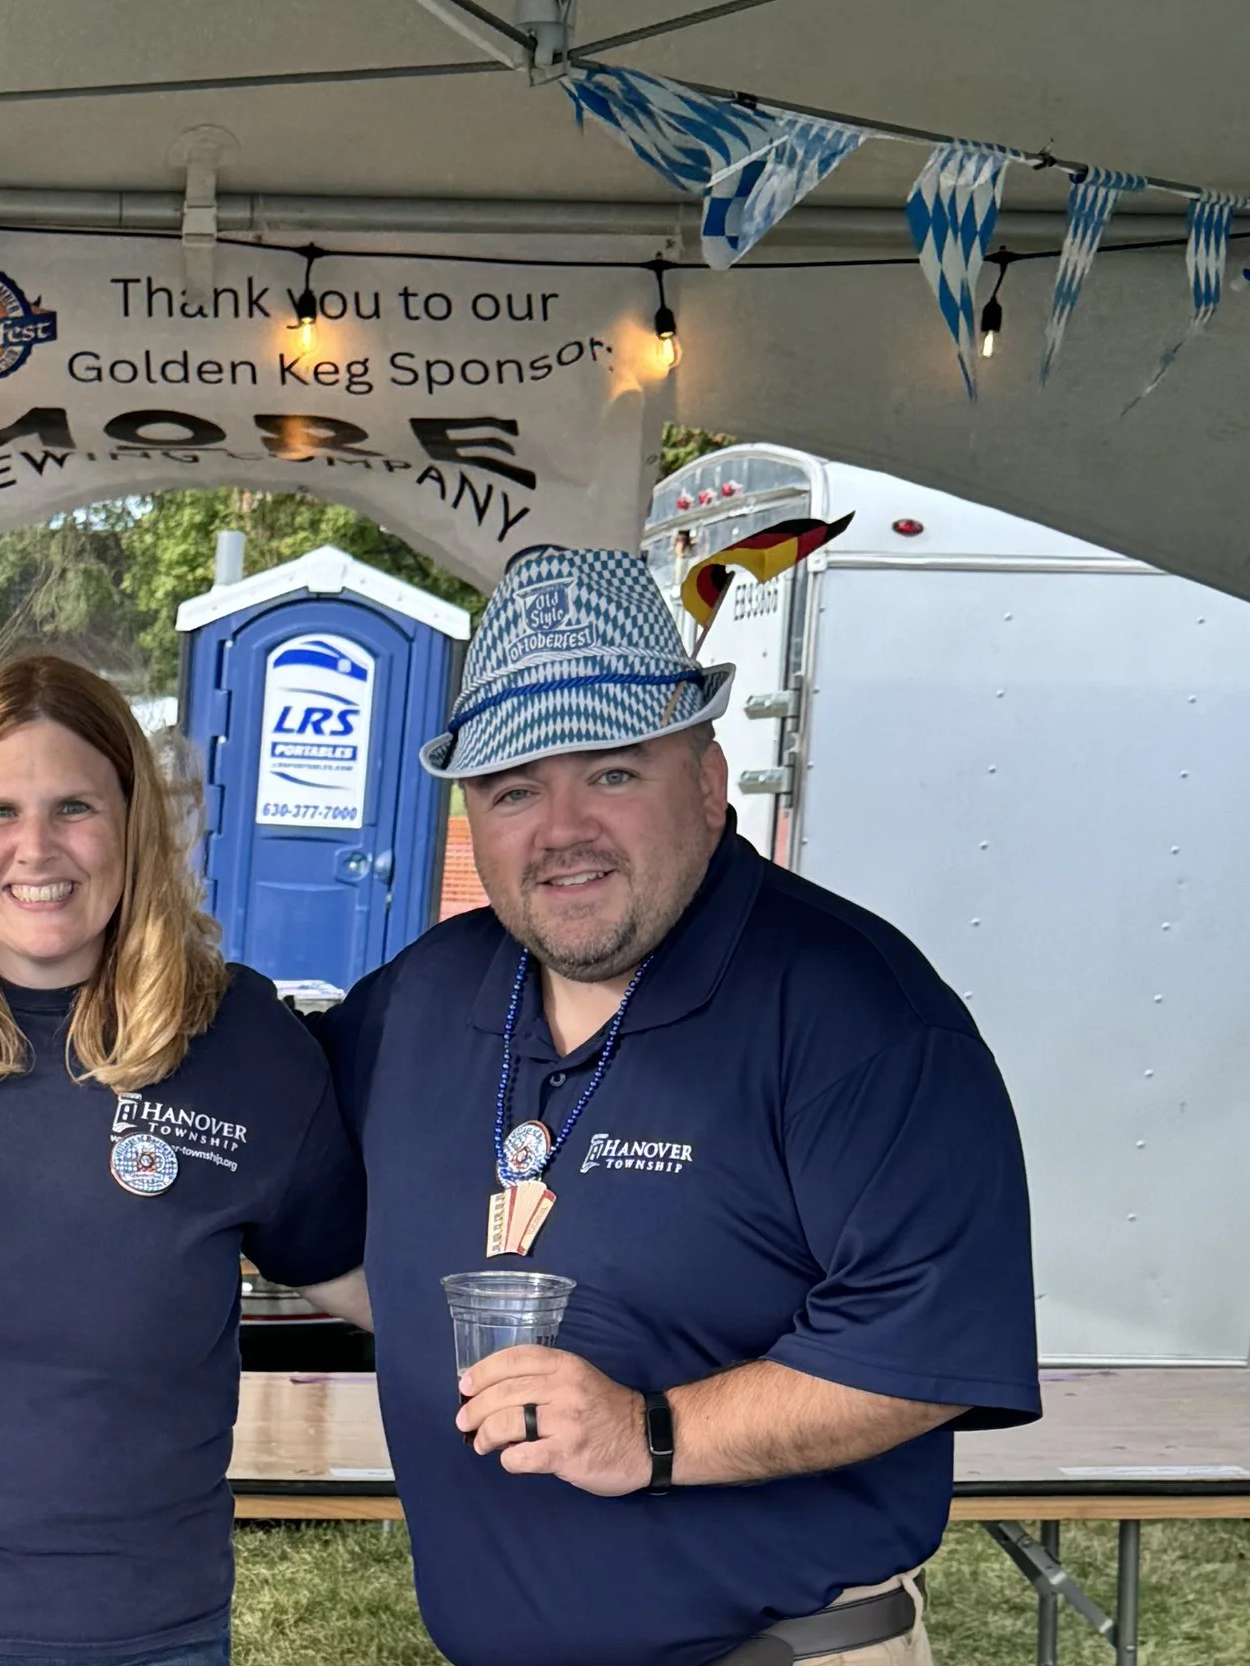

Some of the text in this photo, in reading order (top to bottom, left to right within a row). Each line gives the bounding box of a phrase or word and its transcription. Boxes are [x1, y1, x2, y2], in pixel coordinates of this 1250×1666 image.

[111, 277, 270, 319] Thank
[399, 286, 452, 321] to
[472, 292, 559, 322] our
[68, 351, 256, 385] Golden
[278, 353, 374, 395] Keg
[535, 591, 559, 610] Old
[530, 607, 564, 629] Style
[272, 706, 360, 736] LRS
[274, 744, 354, 759] PORTABLES
[262, 803, 358, 821] 630-377-7000
[141, 1101, 247, 1143] HANOVER
[148, 1122, 239, 1151] TOWNSHIP
[601, 1140, 693, 1162] HANOVER
[606, 1158, 683, 1174] TOWNSHIP
